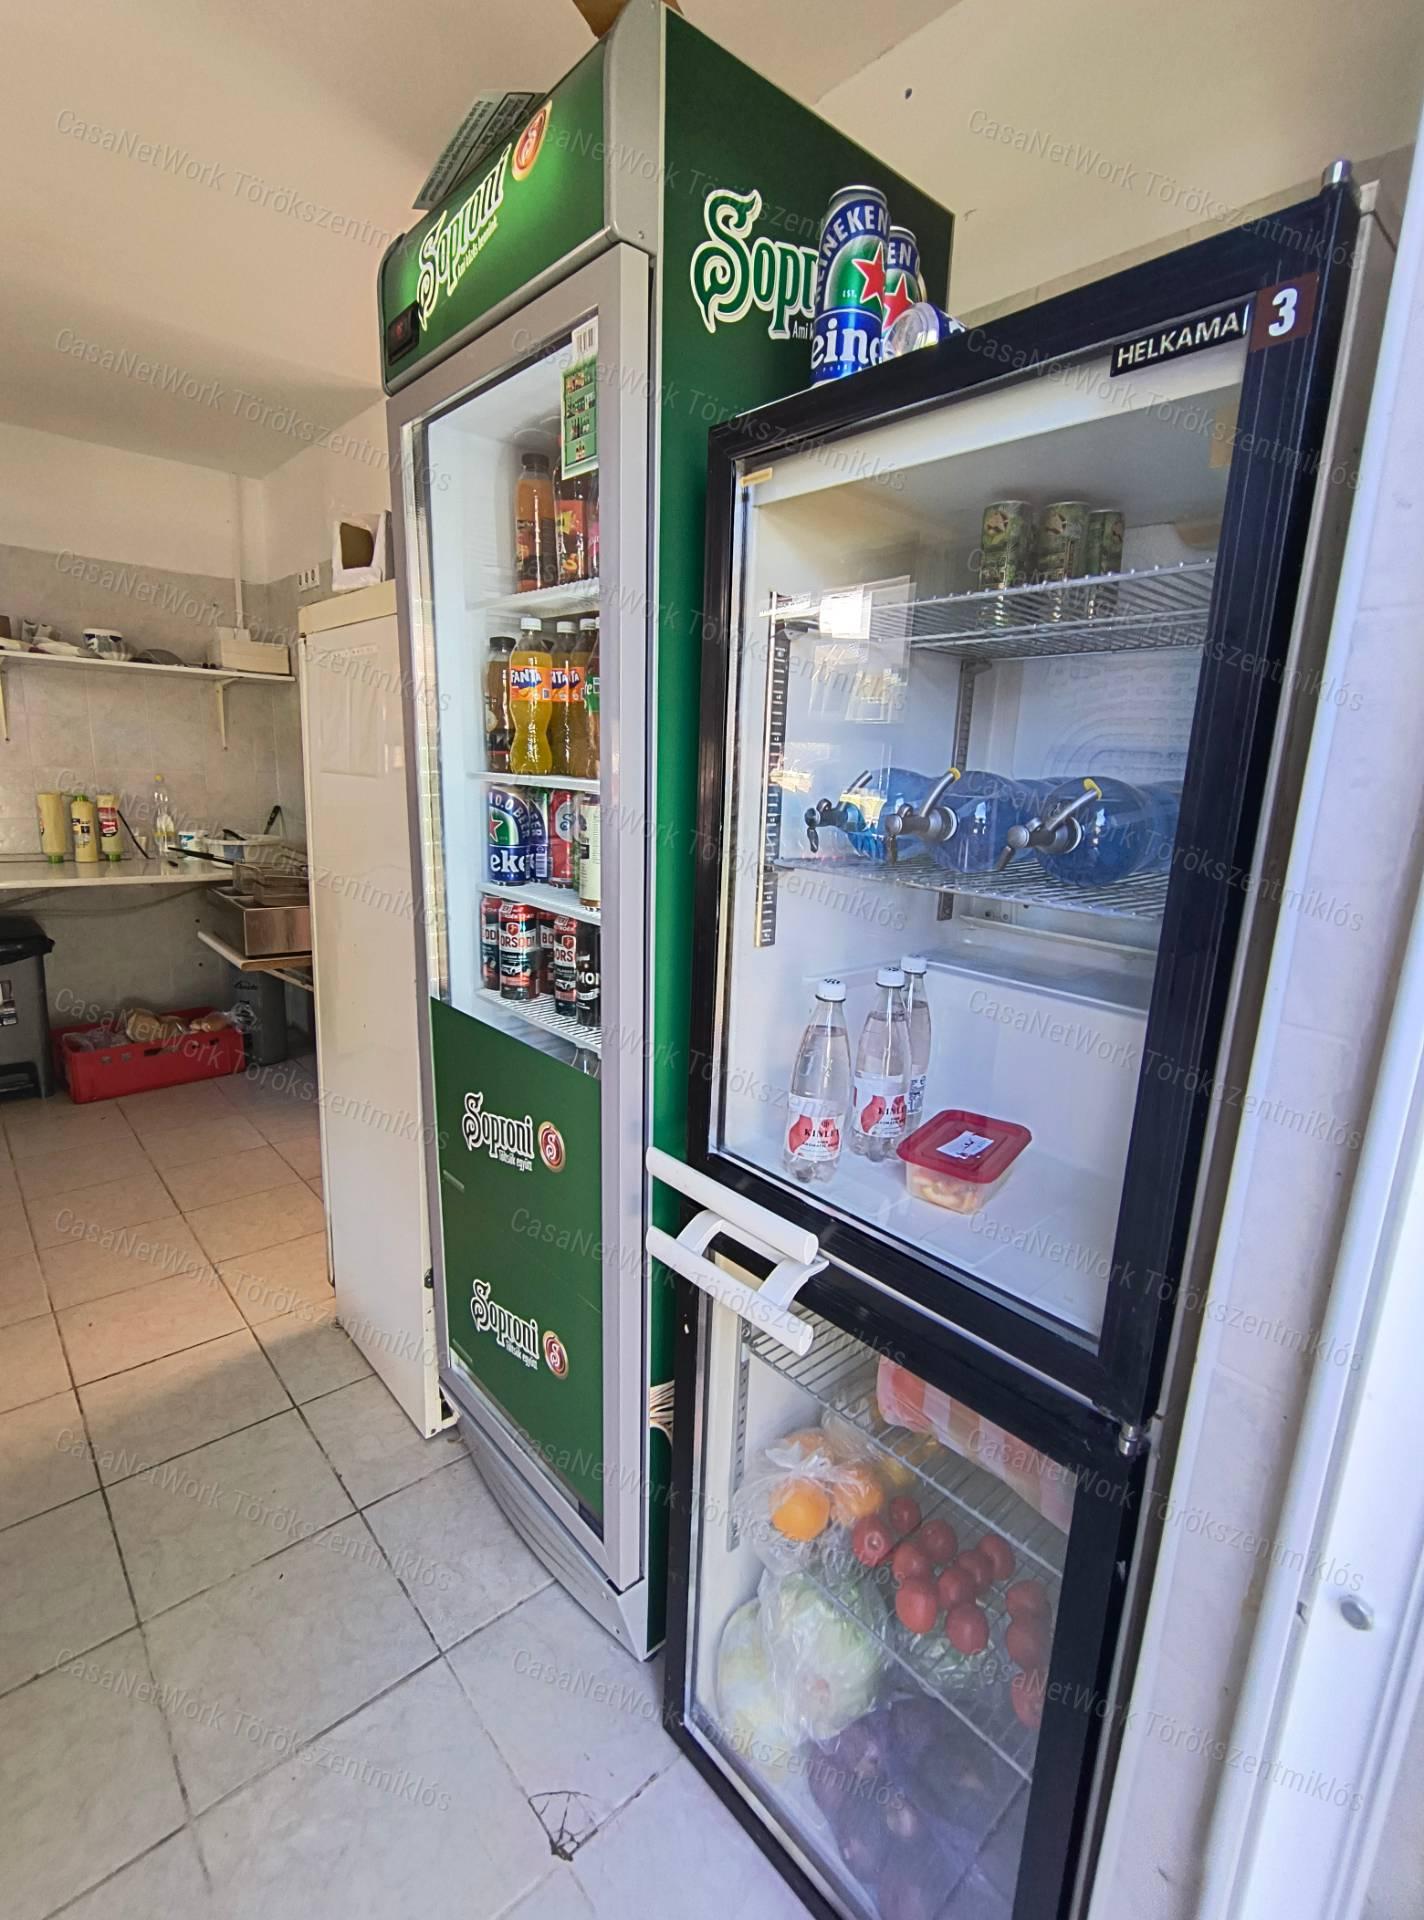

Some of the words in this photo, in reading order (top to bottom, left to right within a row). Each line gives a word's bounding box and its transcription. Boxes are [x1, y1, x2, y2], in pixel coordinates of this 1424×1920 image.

[1117, 311, 1240, 369] HELKAMA
[1268, 287, 1298, 337] 3
[511, 668, 542, 684] FANTA
[462, 1091, 535, 1159] Soproni
[471, 1279, 540, 1360] Soproni
